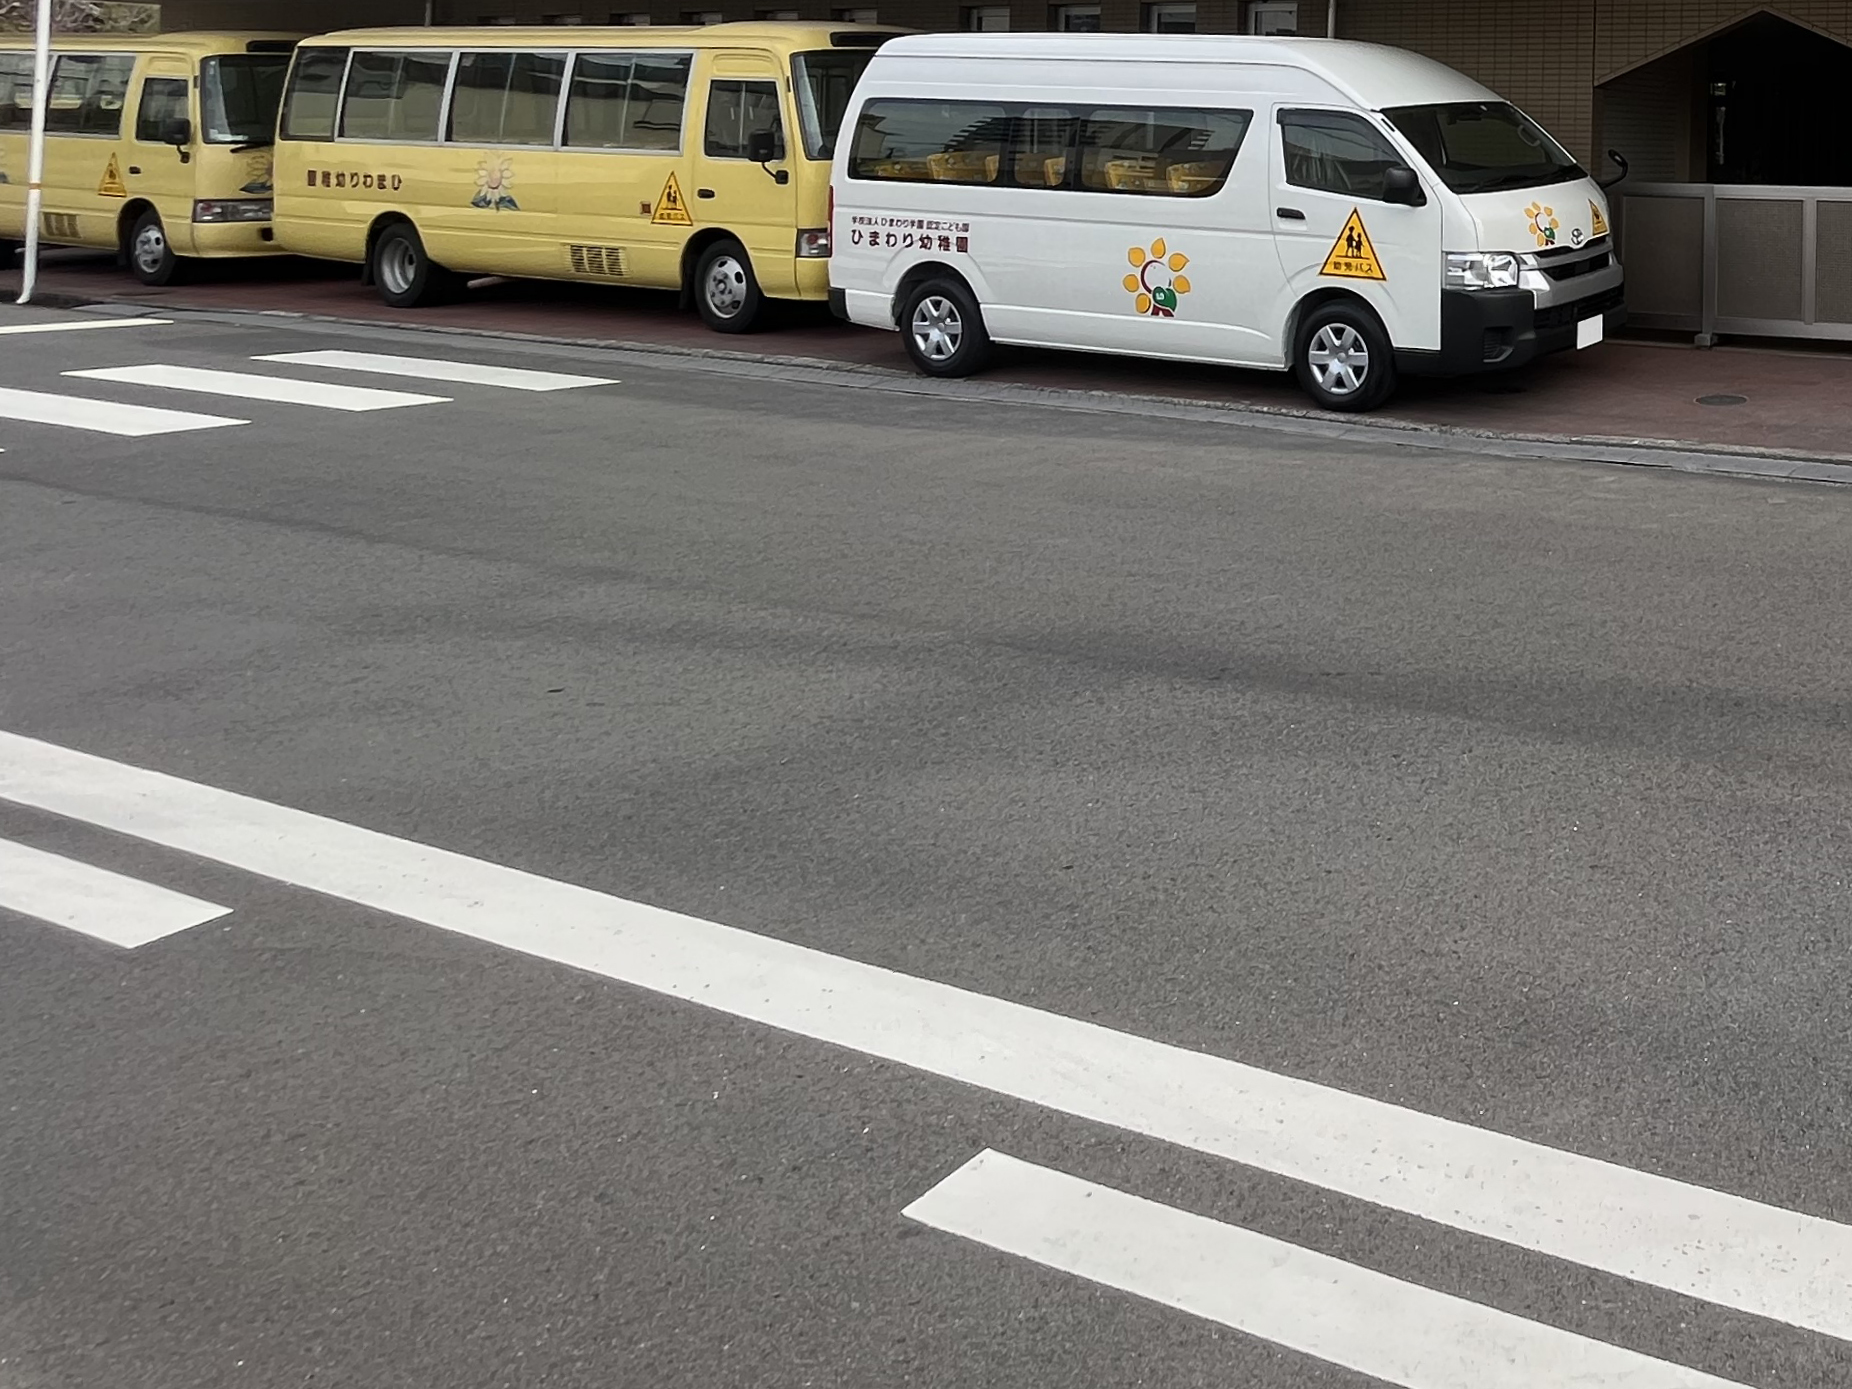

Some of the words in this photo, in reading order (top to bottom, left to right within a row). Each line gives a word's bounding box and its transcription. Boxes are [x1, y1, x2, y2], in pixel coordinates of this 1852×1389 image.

[851, 229, 968, 253] ひまわり幼稚園
